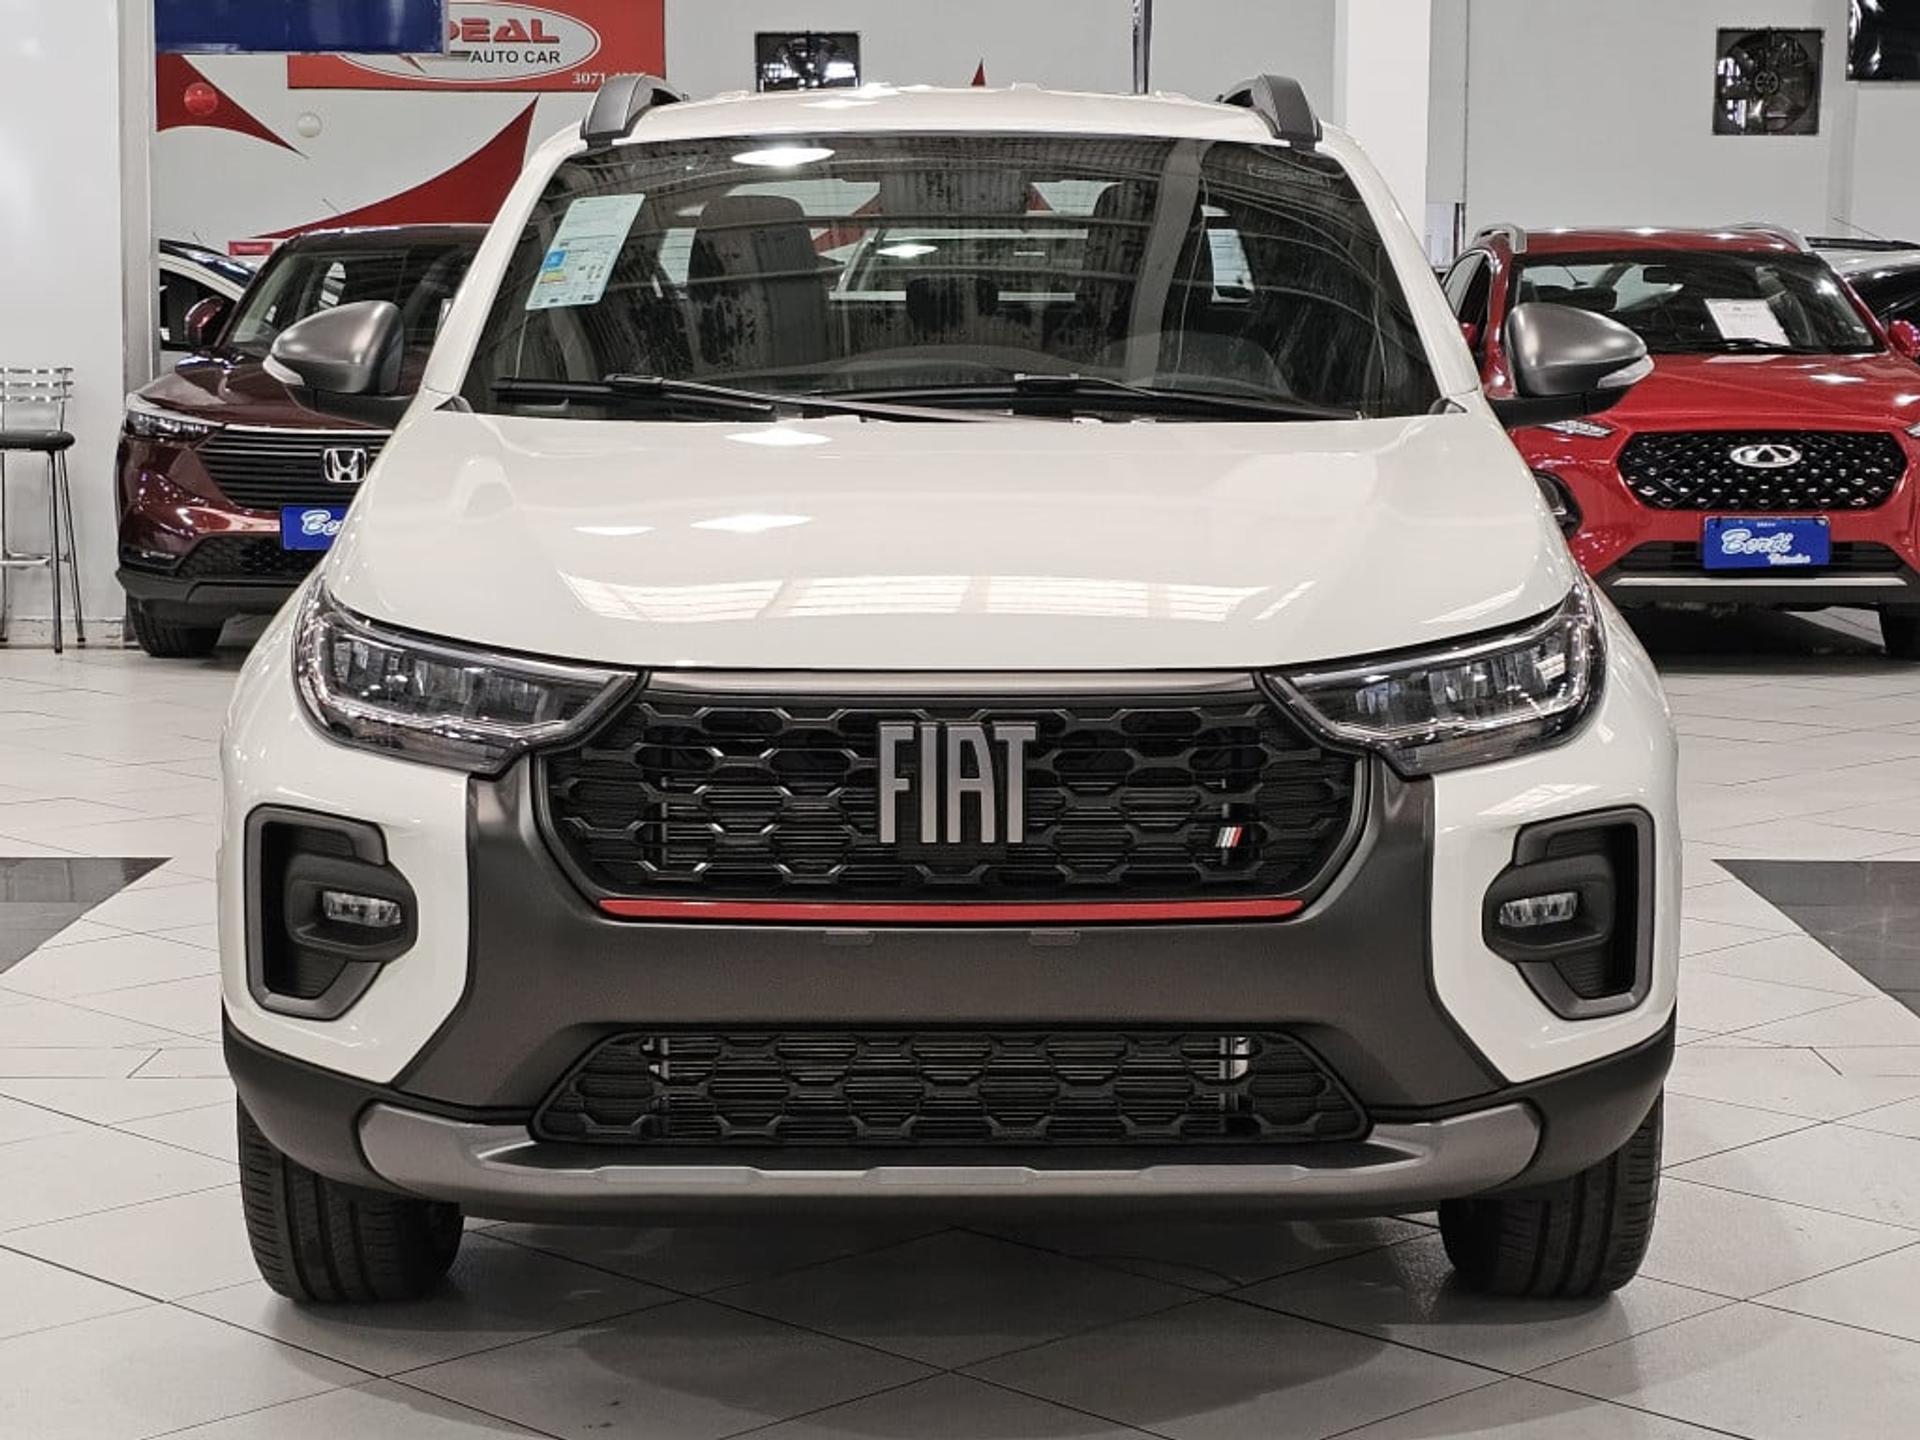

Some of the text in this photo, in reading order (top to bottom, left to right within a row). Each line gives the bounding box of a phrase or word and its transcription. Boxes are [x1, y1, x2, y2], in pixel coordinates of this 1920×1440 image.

[470, 51, 560, 64] AUTO CAR
[301, 509, 342, 536] Be
[878, 721, 1037, 843] FIAT
